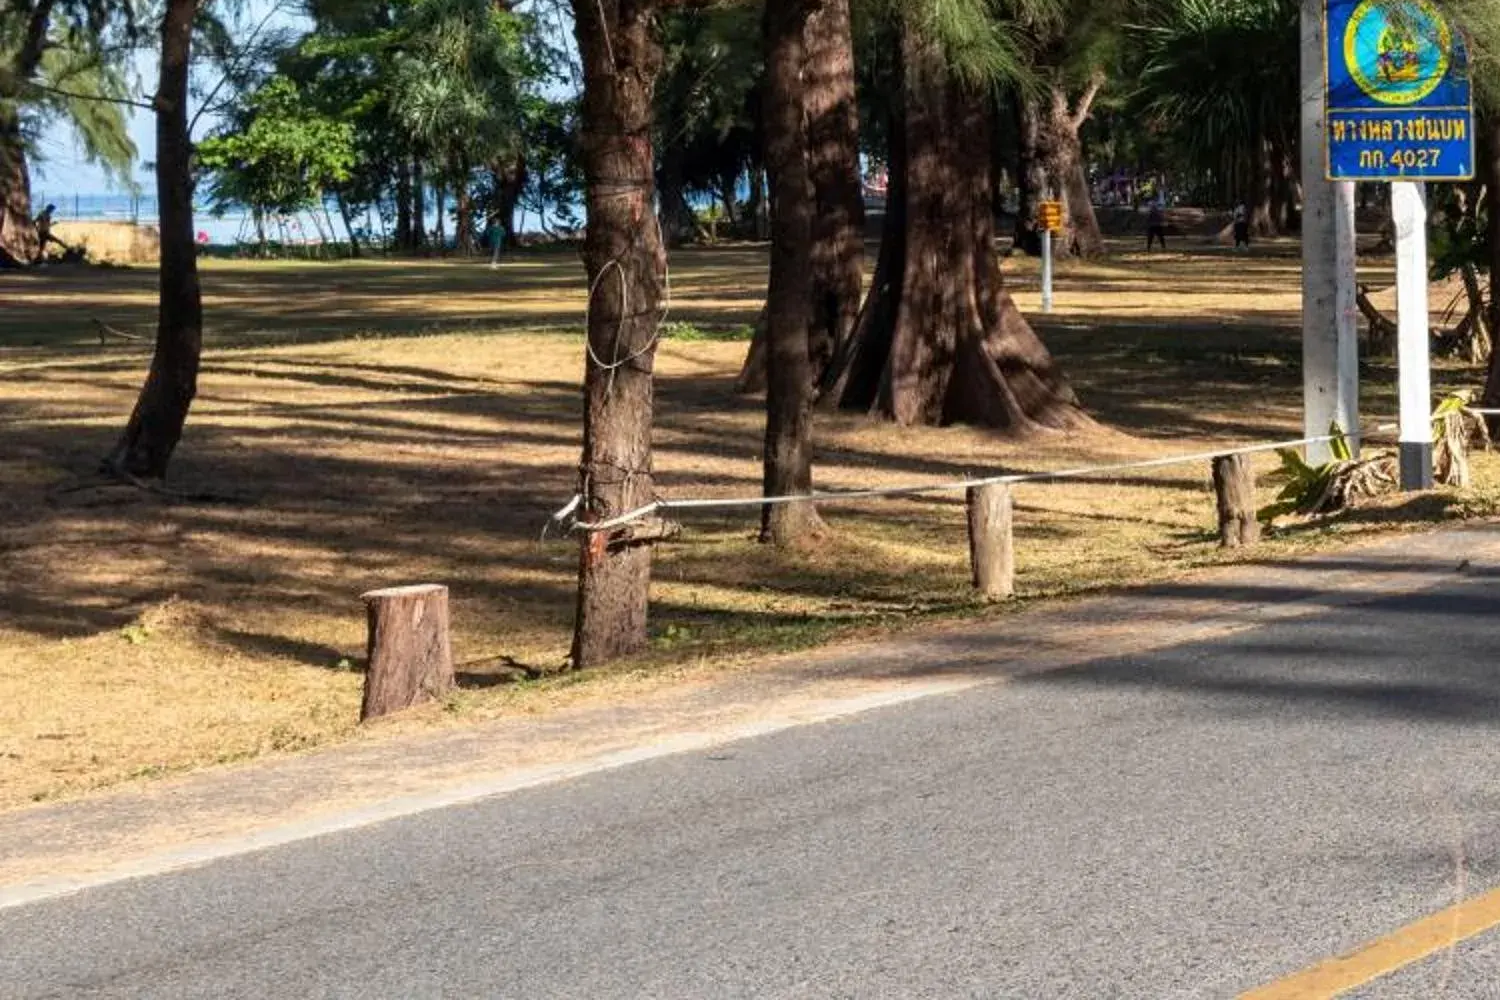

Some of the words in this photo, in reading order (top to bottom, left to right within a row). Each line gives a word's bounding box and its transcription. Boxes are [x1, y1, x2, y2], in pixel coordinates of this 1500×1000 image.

[1332, 116, 1466, 141] ทางหลวงชนบท
